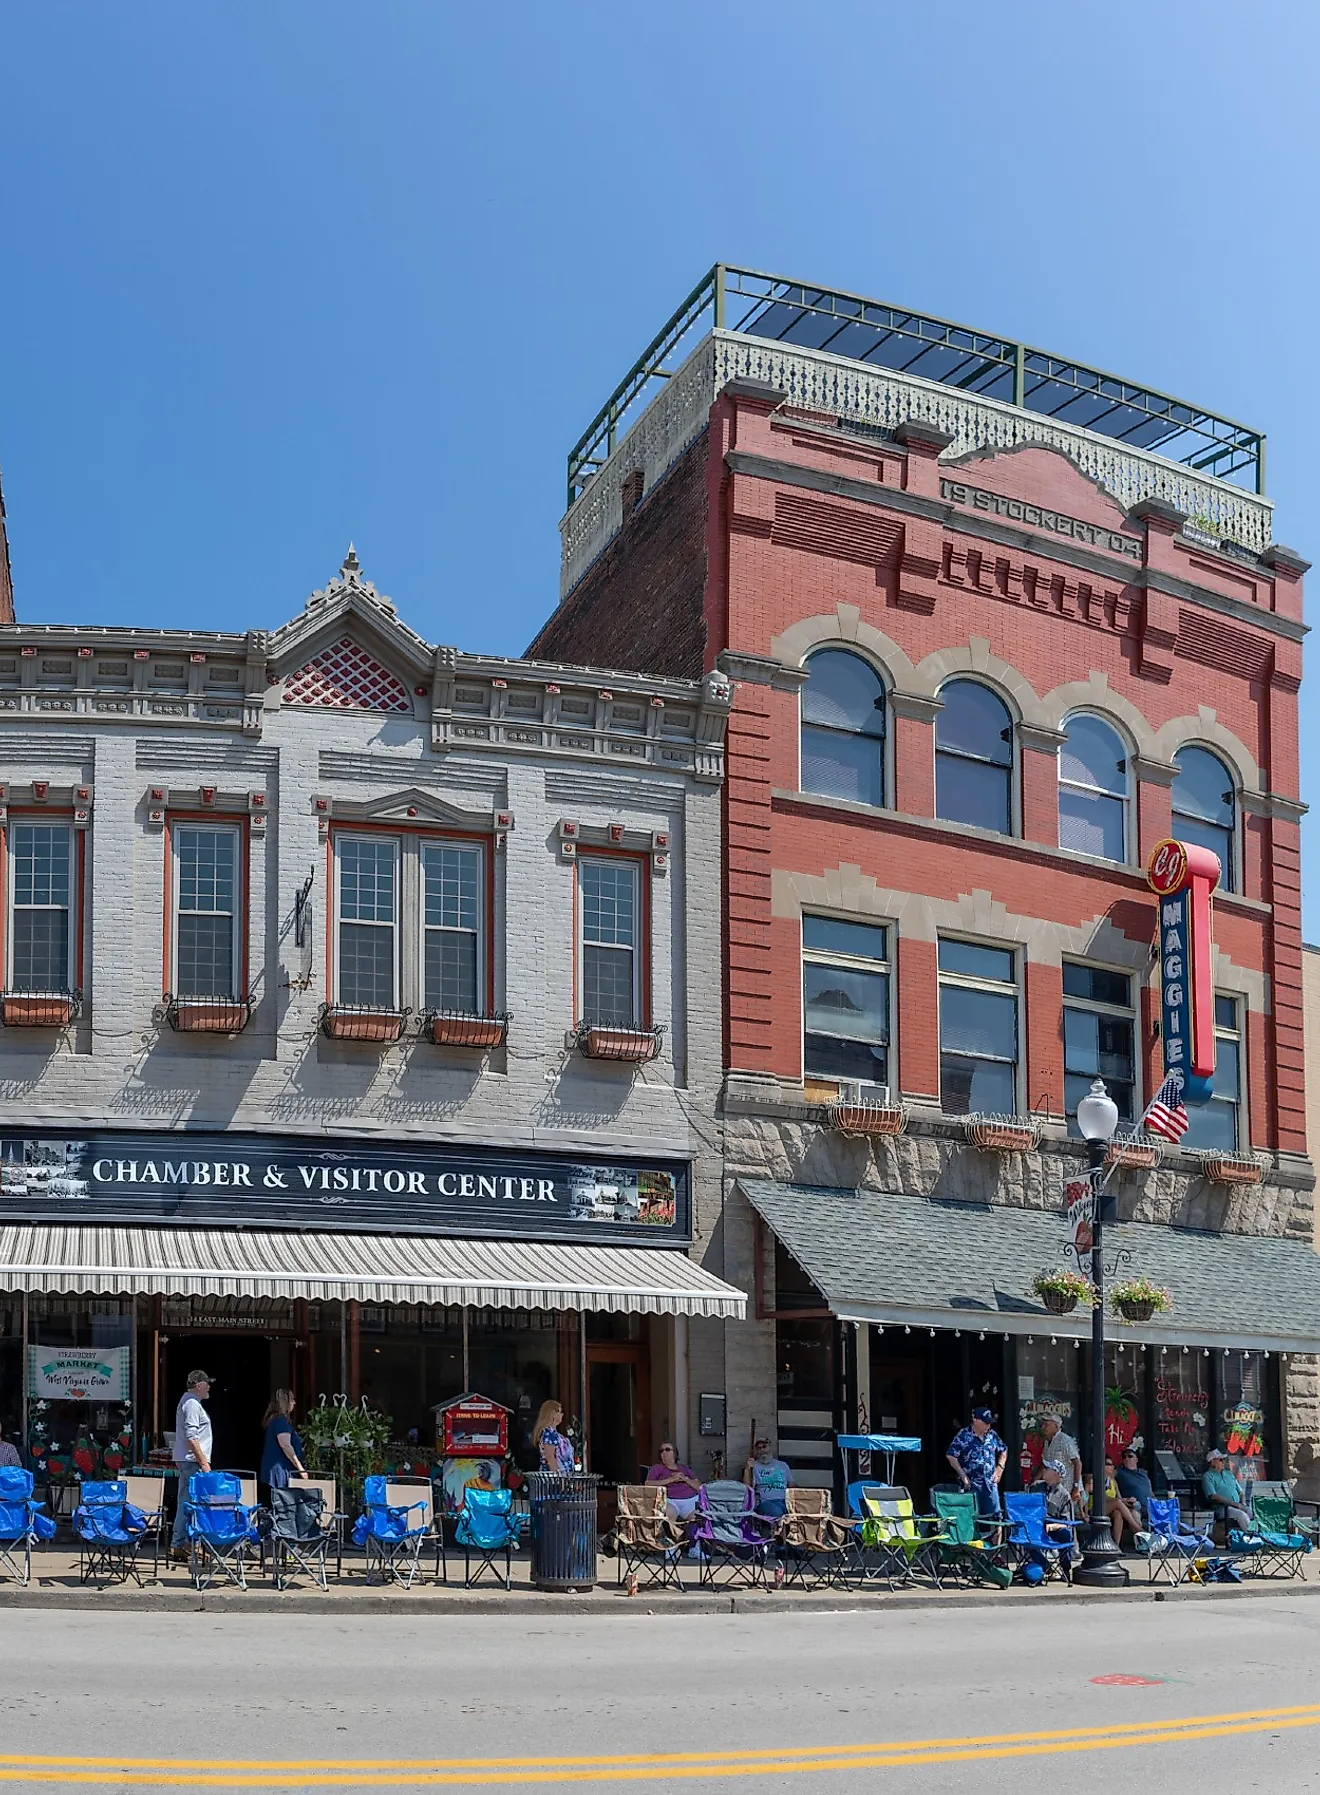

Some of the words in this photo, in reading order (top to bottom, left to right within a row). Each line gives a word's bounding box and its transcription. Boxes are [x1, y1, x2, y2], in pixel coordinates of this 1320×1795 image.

[941, 480, 968, 505] 19
[974, 490, 1103, 544] STOCKERT
[1162, 901, 1185, 1091] MAGGIES
[92, 1158, 255, 1187] CHAMBER
[262, 1164, 289, 1188] &
[297, 1165, 429, 1195] VISITOR
[437, 1173, 559, 1203] CENTER
[56, 1360, 100, 1369] MARKET
[1107, 1423, 1125, 1445] Hi
